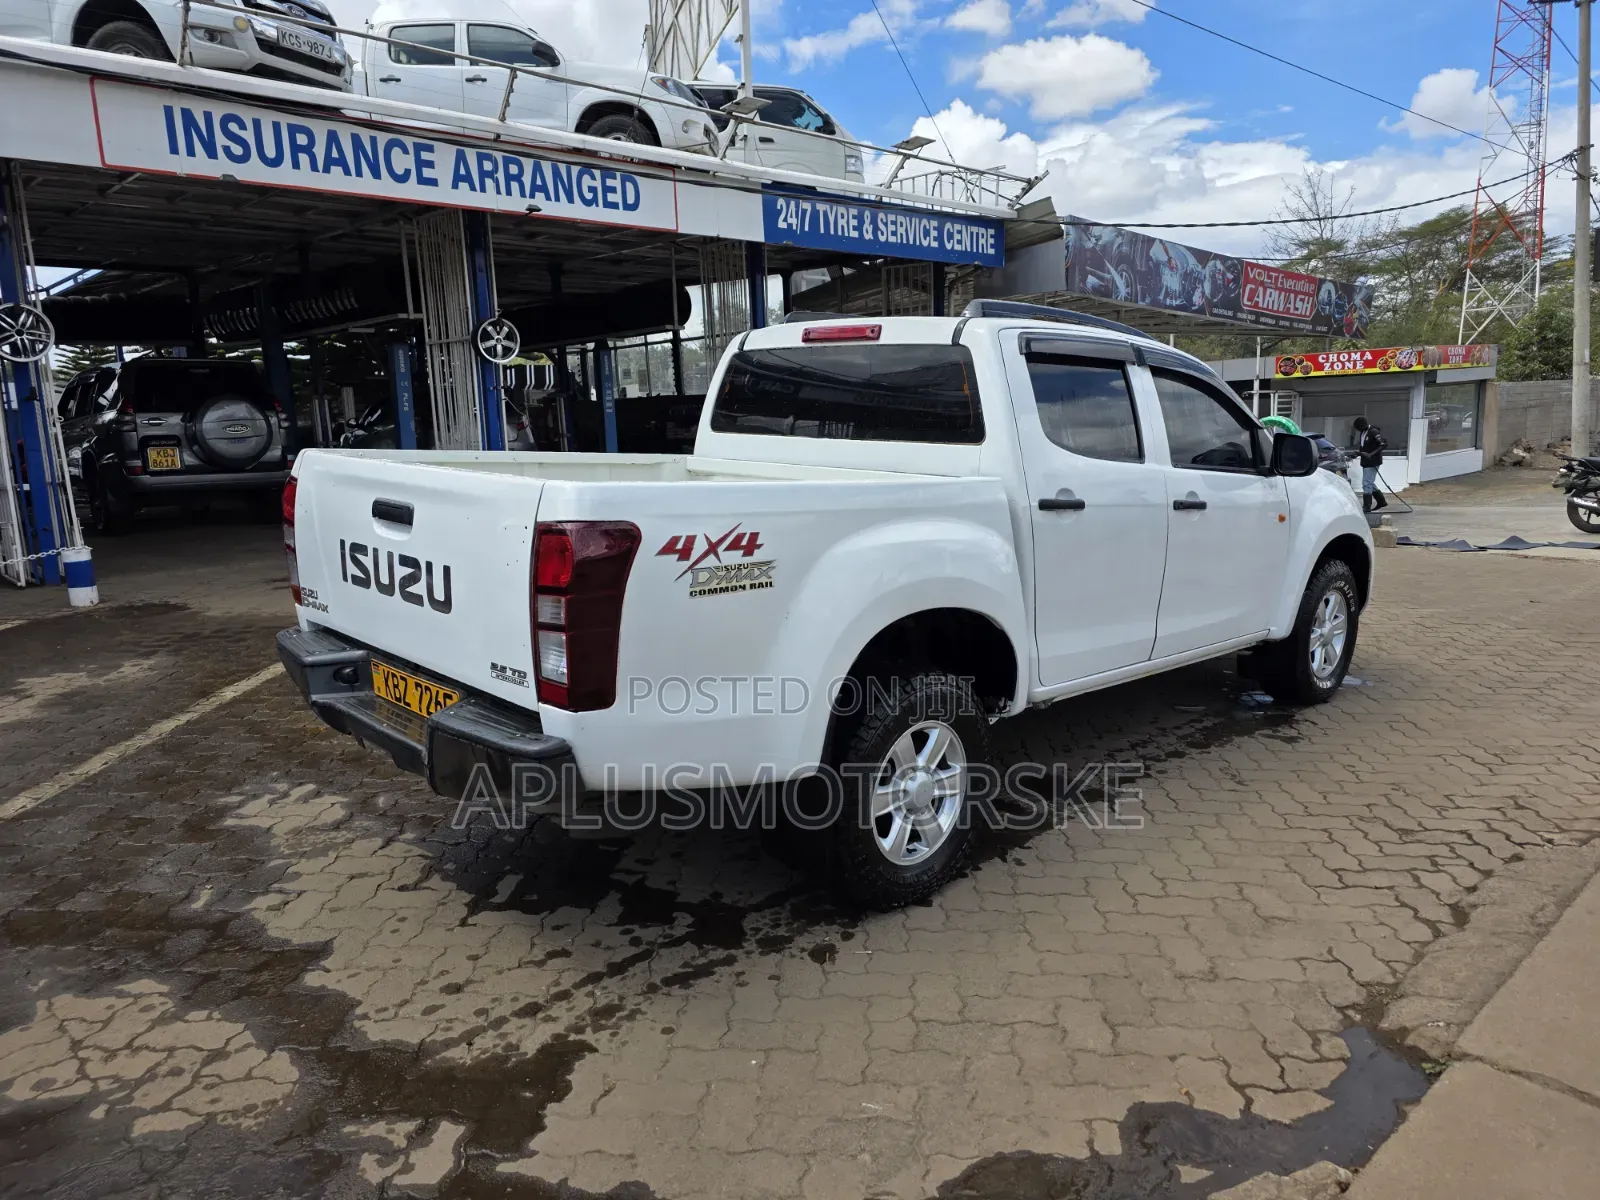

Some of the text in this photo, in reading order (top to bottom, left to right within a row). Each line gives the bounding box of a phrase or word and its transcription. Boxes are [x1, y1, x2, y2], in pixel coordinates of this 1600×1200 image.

[163, 105, 641, 212] INSURANCE ARRANGED
[776, 197, 996, 254] 24/7 TYRE & SERVICE CENTRE
[1248, 266, 1315, 294] VOLT Executive
[1243, 283, 1313, 316] CARWASH
[1318, 351, 1373, 363] CHOMA
[1323, 360, 1365, 371] ZONE
[156, 449, 175, 458] KBJ
[152, 459, 177, 468] 861A
[340, 538, 452, 614] ISUZU
[721, 563, 749, 572] ISUZU
[300, 586, 319, 600] SUZU
[689, 581, 774, 598] COMMON RAIL
[383, 668, 411, 708] KBZ
